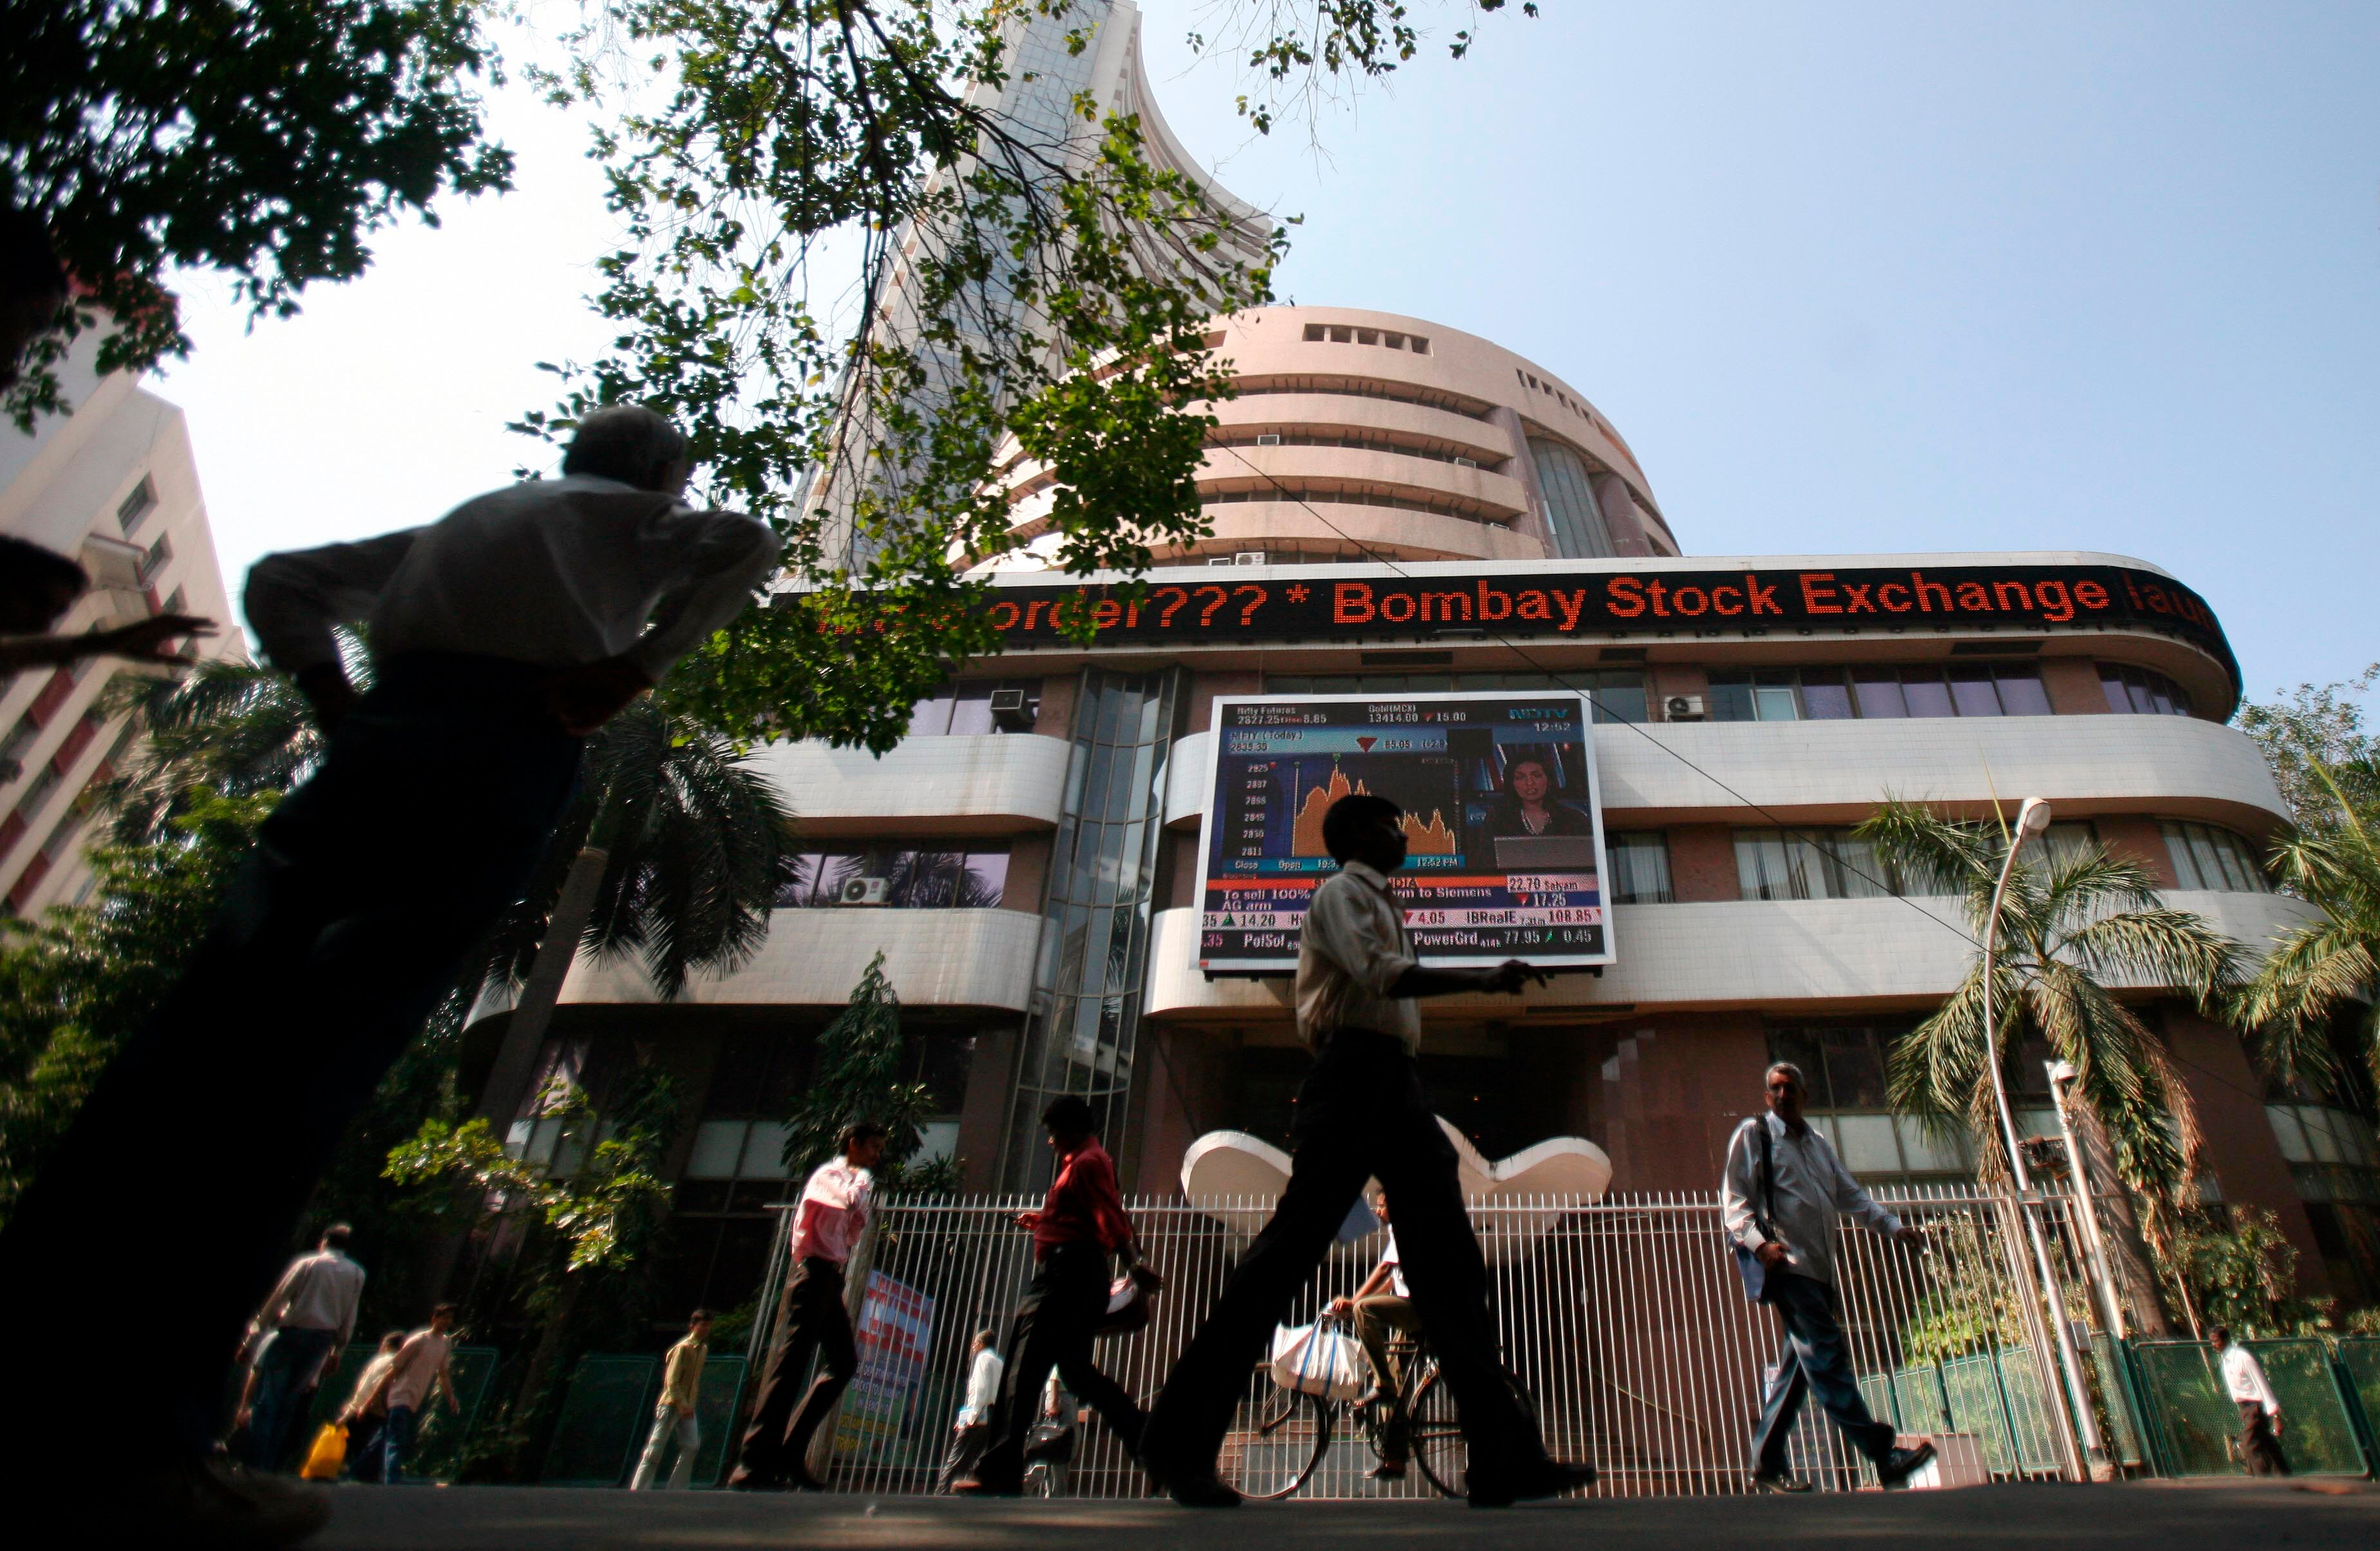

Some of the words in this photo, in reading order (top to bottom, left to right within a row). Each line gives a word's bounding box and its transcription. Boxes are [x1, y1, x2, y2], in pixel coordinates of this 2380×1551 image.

[1333, 580, 1587, 631] Bombay
[1606, 574, 1783, 618] Stock
[1799, 571, 2110, 622] Exchange
[1223, 890, 1240, 900] To
[1243, 889, 1265, 900] sell
[1272, 888, 1311, 900] 100%
[1419, 888, 1432, 898] to
[1436, 886, 1493, 899] Siemens
[1222, 900, 1242, 911] AG
[1245, 902, 1272, 911] arm
[1242, 914, 1276, 927] 14.20
